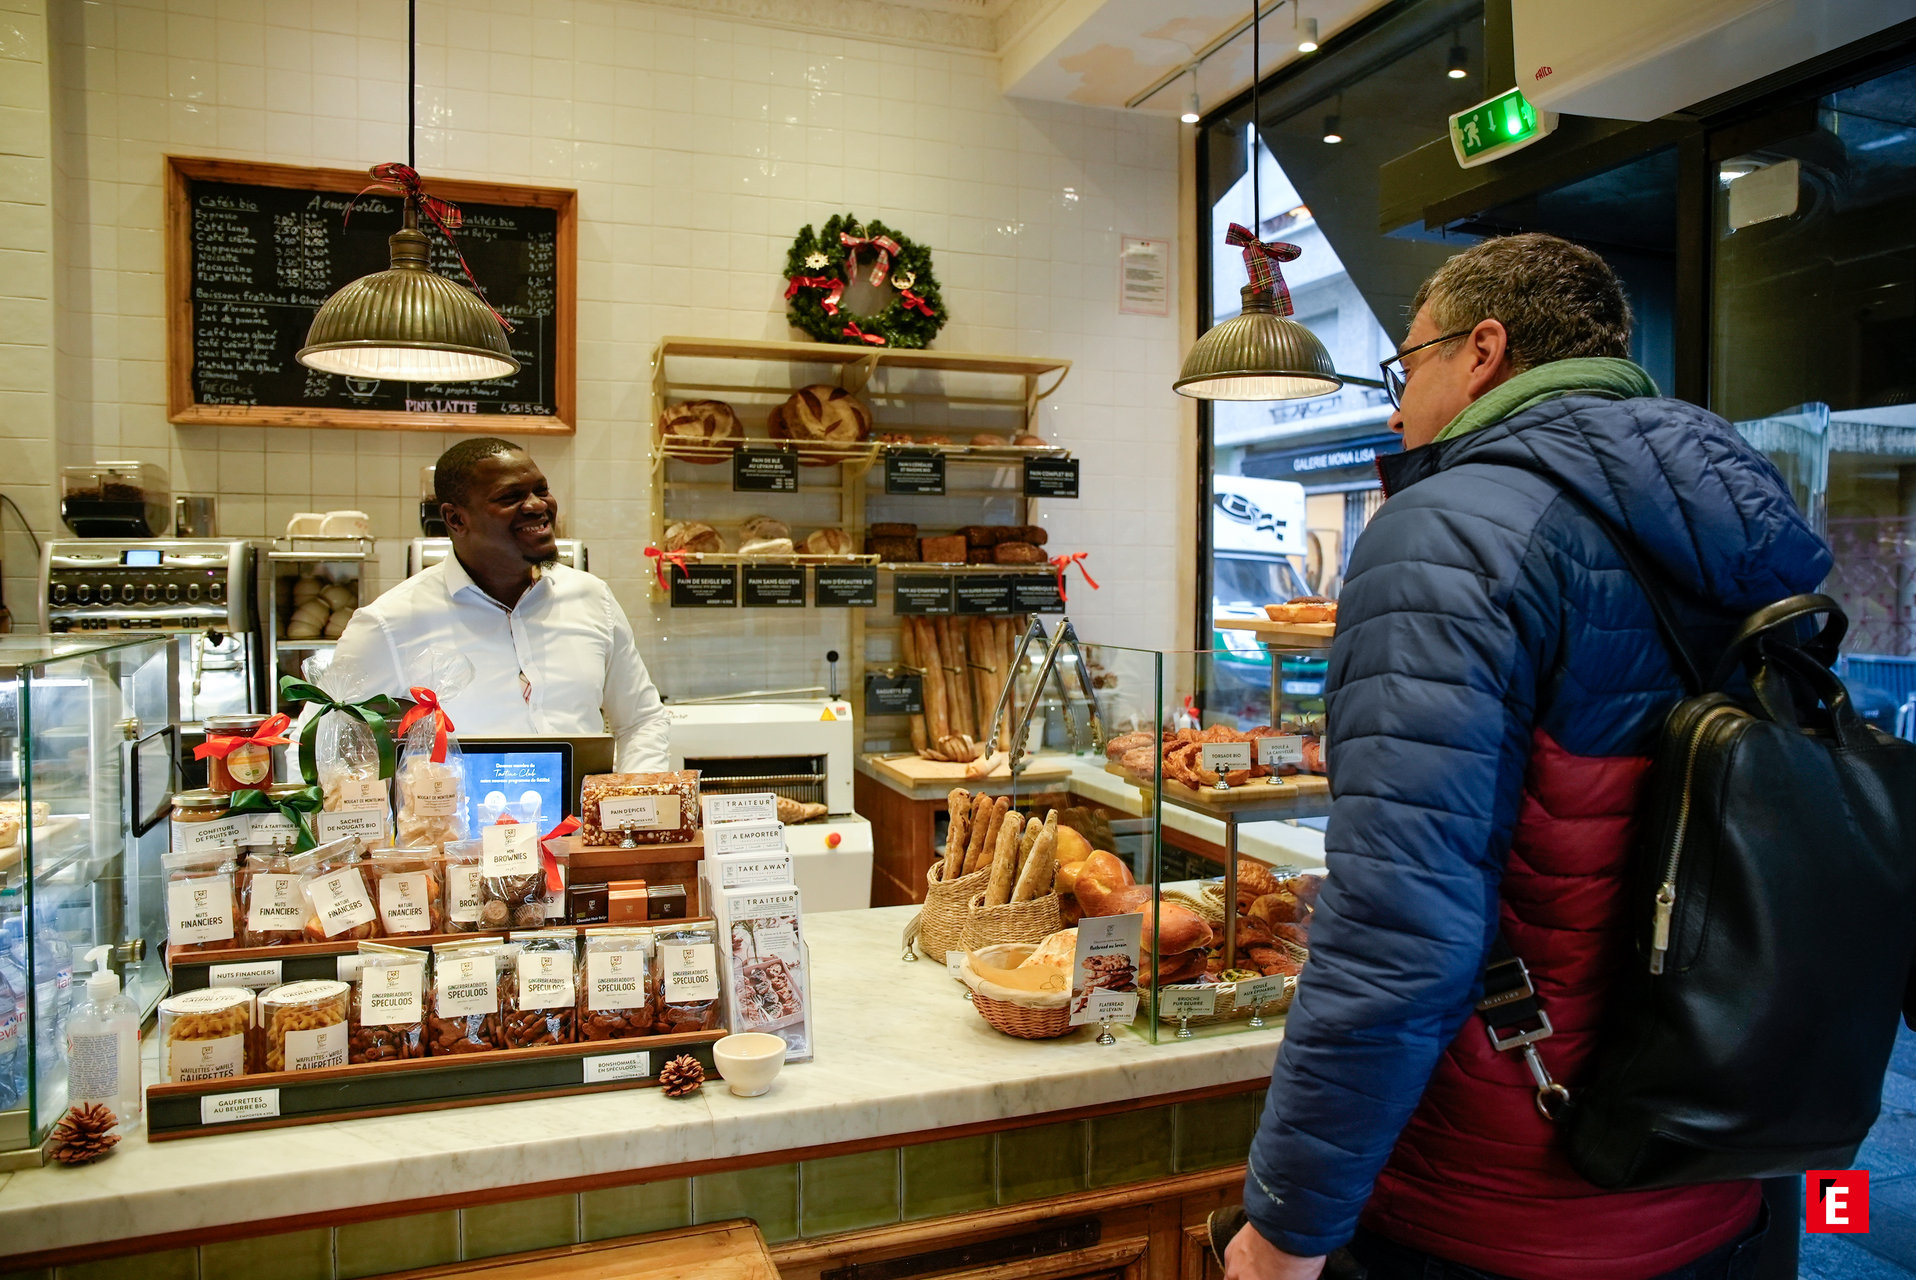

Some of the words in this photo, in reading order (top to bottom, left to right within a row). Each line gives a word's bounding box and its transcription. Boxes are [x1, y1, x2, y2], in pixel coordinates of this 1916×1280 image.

[405, 399, 436, 412] PINK
[436, 400, 478, 413] LATTE
[1293, 454, 1328, 471] GALERIE
[1328, 450, 1354, 466] MONA
[1354, 447, 1376, 463] LISA
[518, 768, 537, 777] Club
[726, 799, 770, 807] TRAITEUR
[198, 824, 235, 837] CONFITURE
[337, 823, 365, 831] NOUGATS
[205, 833, 227, 841] FRUITS
[228, 829, 240, 837] BIO
[739, 831, 779, 839] EMPORTER
[493, 852, 528, 863] BROWNIES
[738, 864, 759, 872] TAKE
[747, 895, 794, 905] TRAITEUR
[259, 907, 300, 916] FINANCIERS
[327, 900, 363, 918] FINANCIERS
[388, 908, 423, 918] FINANCIERS
[181, 916, 223, 929] FINANCIERS
[235, 969, 276, 977] FINANCIERS
[673, 976, 710, 985] SPECULOOS
[528, 983, 567, 992] SPECULOOS
[597, 983, 636, 992] SPECULOOS
[448, 988, 488, 1000] SPECULOOS
[371, 998, 413, 1008] SPECULOOS
[295, 1056, 343, 1071] GAUFRETTES
[598, 1060, 637, 1068] BONSHOMMES
[180, 1069, 234, 1083] GAUFRETTES
[219, 1096, 263, 1107] GAUFRETTES
[225, 1105, 253, 1113] BEURRE
